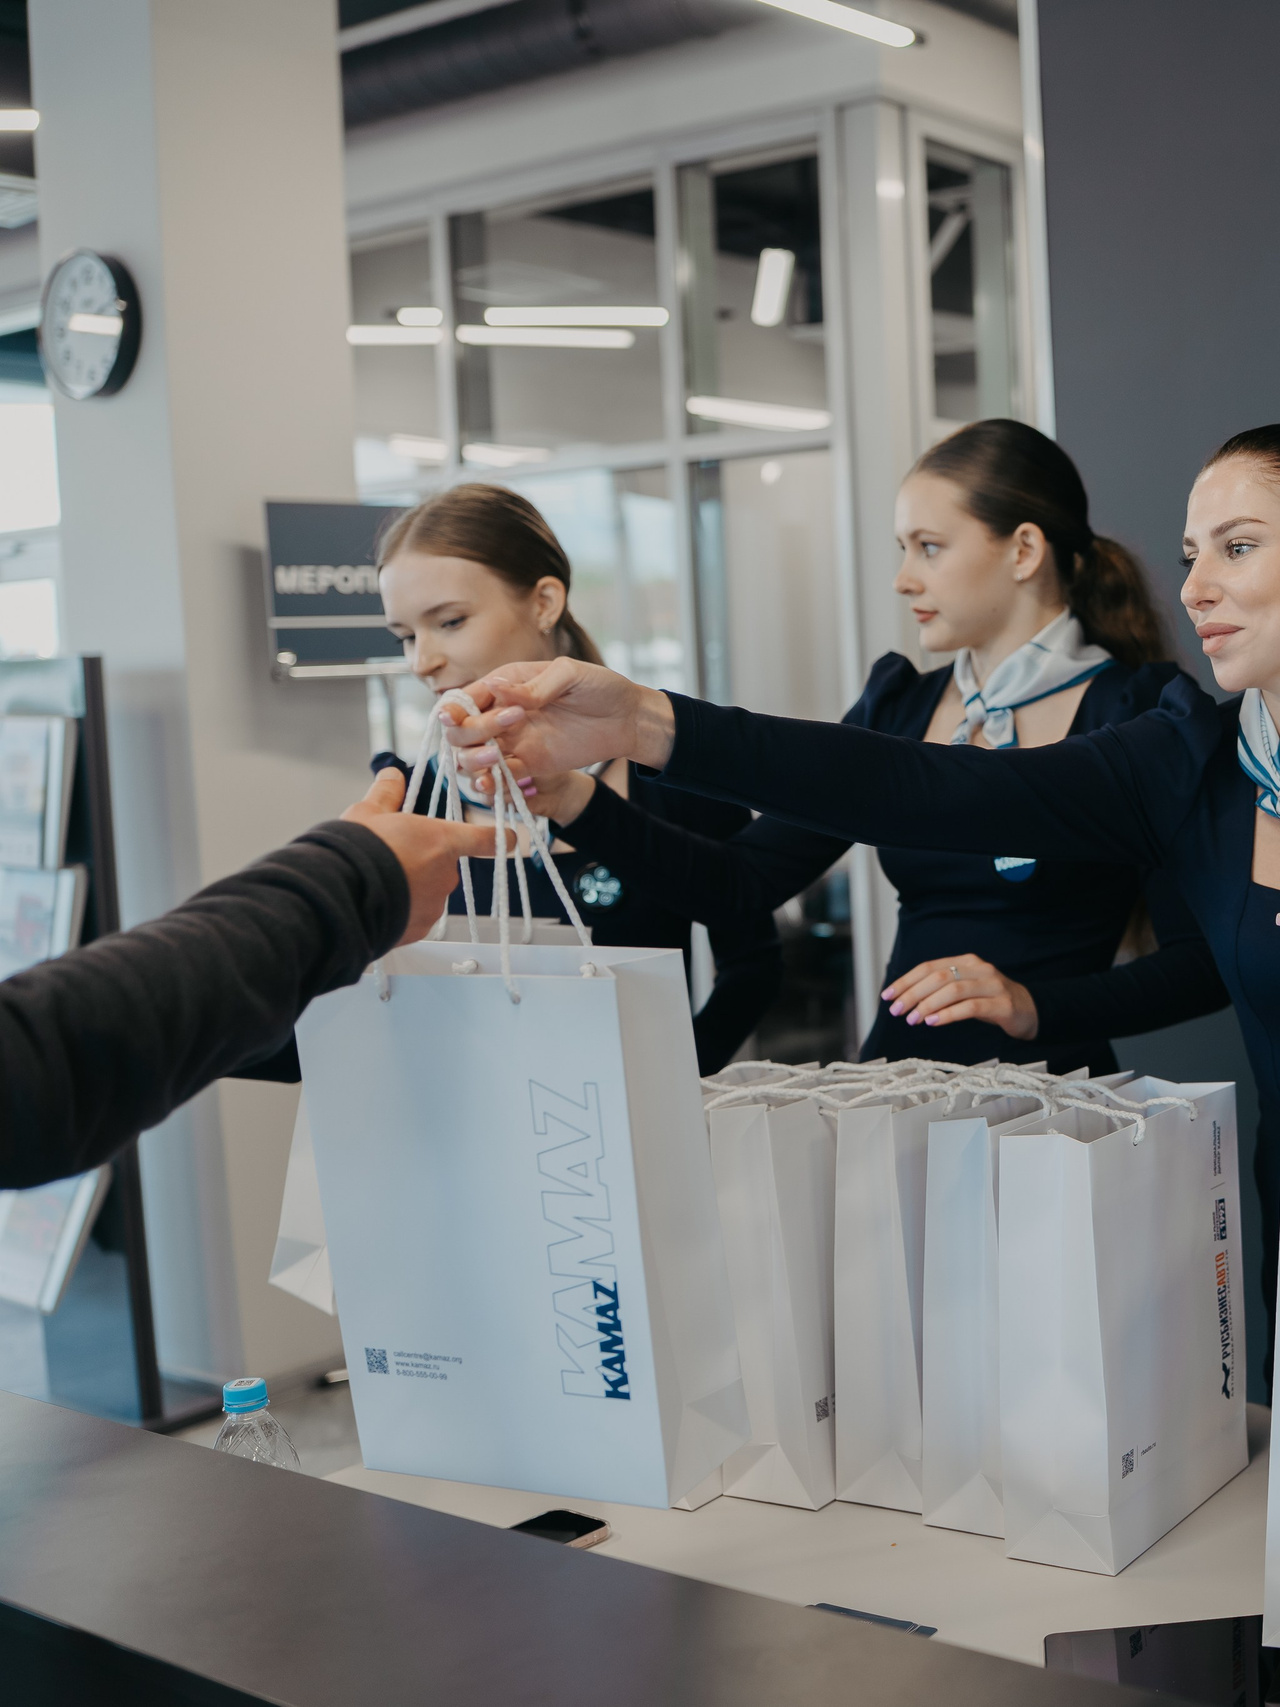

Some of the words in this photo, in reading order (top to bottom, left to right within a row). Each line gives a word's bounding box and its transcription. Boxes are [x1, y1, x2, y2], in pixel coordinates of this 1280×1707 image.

[529, 1079, 630, 1400] KAMAZ
[592, 1280, 631, 1400] KAMAZ
[1214, 1251, 1231, 1360] РУСБИЗНЕСАВТО
[395, 1361, 440, 1370] www.kamaz.ru
[396, 1369, 448, 1380] 8-800-555-00-99
